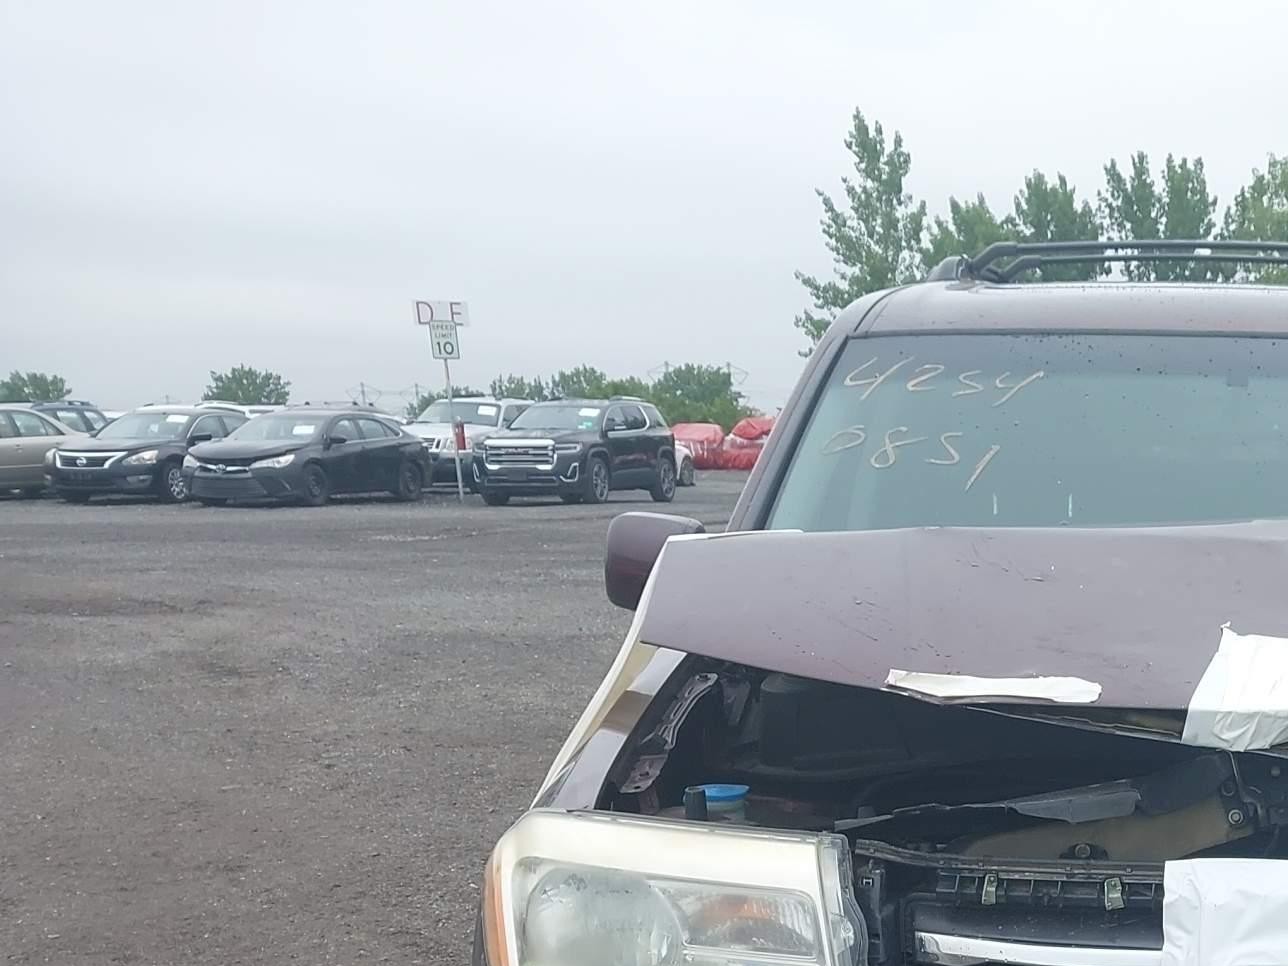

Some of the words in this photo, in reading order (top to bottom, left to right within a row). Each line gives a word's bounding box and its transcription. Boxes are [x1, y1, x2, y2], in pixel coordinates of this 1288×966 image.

[416, 301, 434, 325] D
[450, 302, 464, 326] E
[431, 323, 455, 331] SPEED
[436, 341, 455, 355] 10
[843, 355, 1045, 407] 4254
[821, 424, 1002, 492] 0851
